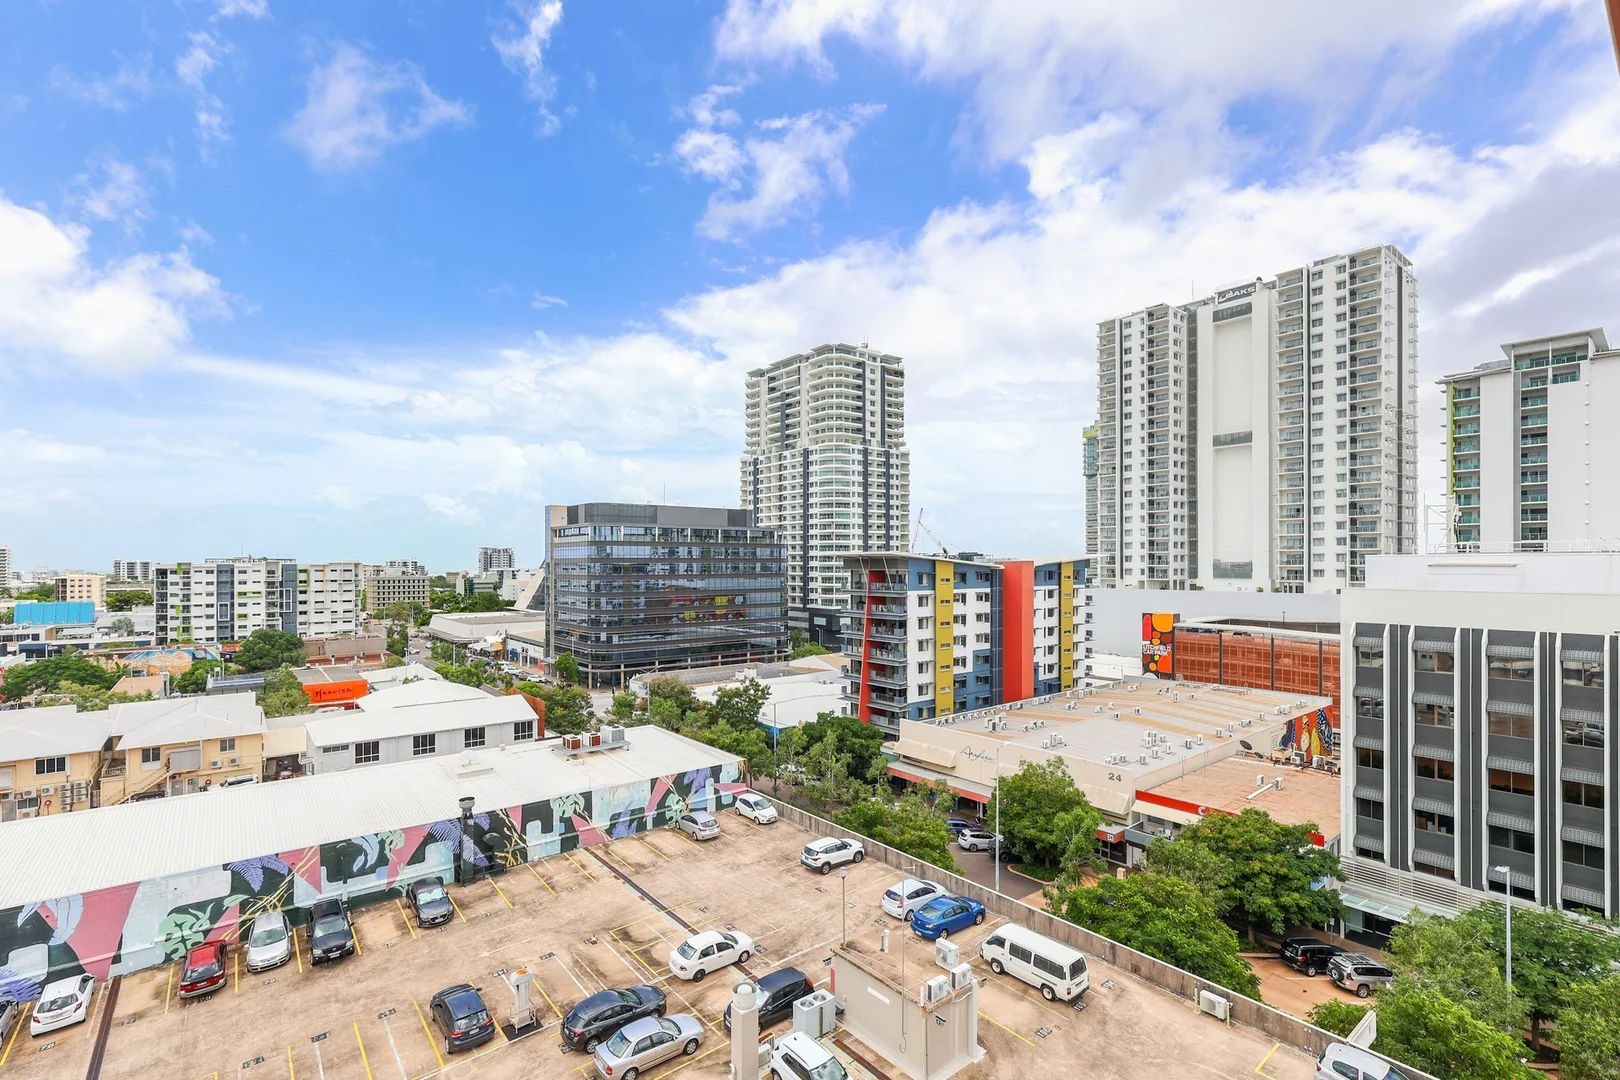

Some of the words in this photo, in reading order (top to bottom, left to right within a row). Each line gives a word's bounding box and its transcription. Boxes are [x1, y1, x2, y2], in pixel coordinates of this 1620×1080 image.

[1218, 286, 1255, 302] OAKS
[315, 687, 352, 700] Moorish
[1108, 772, 1122, 783] 24
